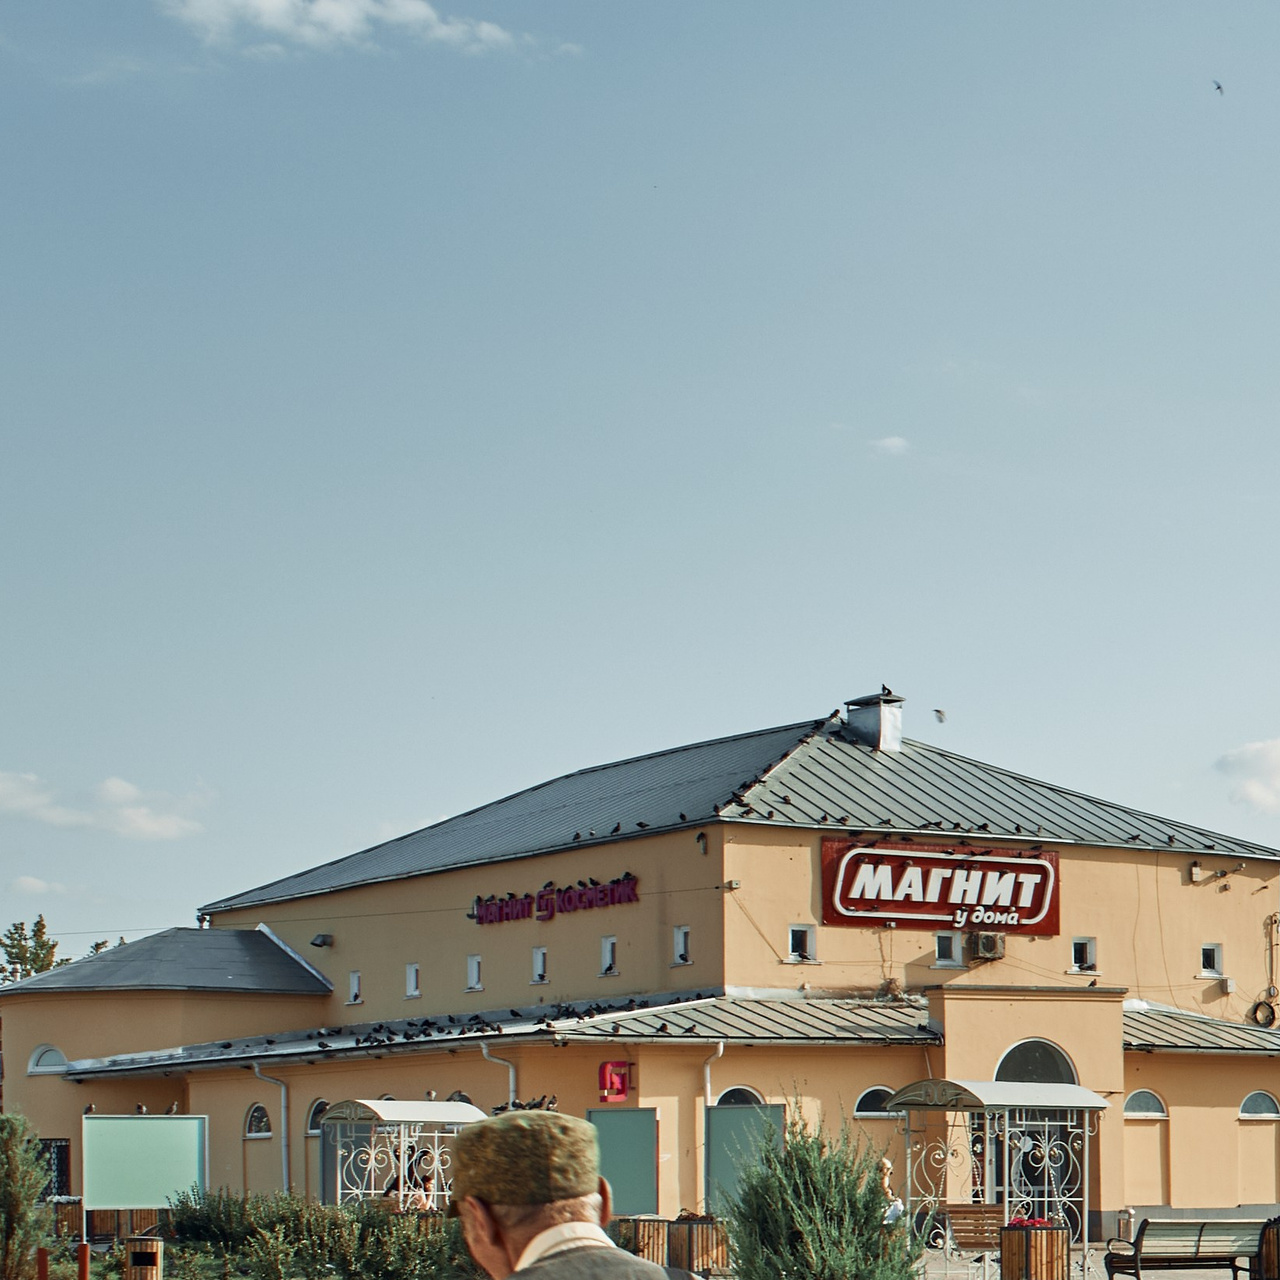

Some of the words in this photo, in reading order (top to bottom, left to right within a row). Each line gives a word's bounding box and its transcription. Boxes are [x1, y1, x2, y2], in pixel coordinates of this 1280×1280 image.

[475, 896, 534, 925] МАГНИТ
[556, 876, 640, 914] КОСМЕТИК
[848, 863, 1042, 908] МАГНИТ
[953, 908, 968, 928] у
[971, 906, 1020, 926] дома
